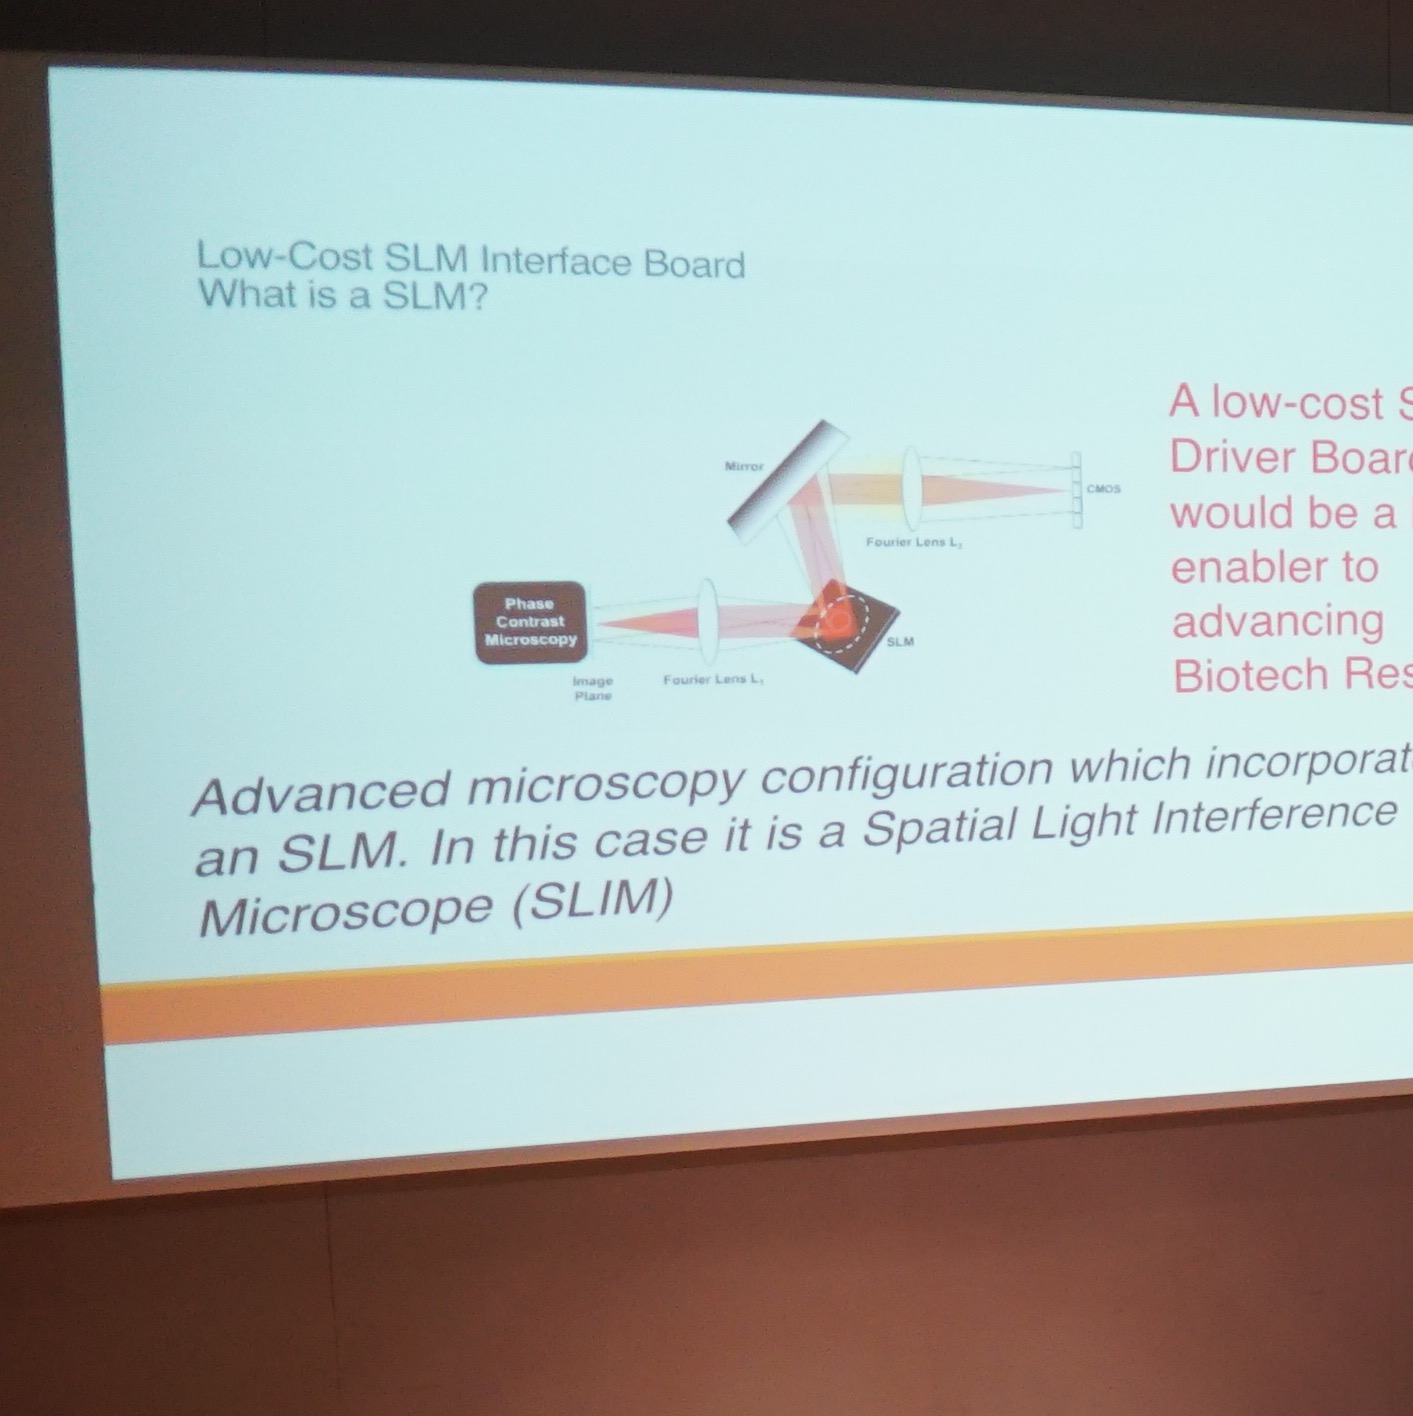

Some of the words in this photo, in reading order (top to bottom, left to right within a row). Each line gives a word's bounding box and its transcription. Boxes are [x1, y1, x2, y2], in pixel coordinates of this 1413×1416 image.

[198, 239, 373, 271] Low-Cost
[385, 242, 467, 272] SLM
[482, 244, 632, 276] Interface
[645, 248, 745, 279] Board
[198, 277, 296, 308] What
[309, 279, 337, 308] is
[350, 286, 370, 308] a
[384, 280, 488, 310] SLM?
[1169, 382, 1200, 417] A
[1213, 383, 1384, 420] low-cost
[725, 461, 765, 472] Mirror
[1171, 438, 1296, 473] Driver
[1087, 484, 1121, 494] CMOS
[1170, 495, 1293, 530] would
[1309, 495, 1358, 528] be
[1374, 503, 1397, 529] a
[866, 536, 912, 548] Fourier
[916, 536, 946, 548] Lens
[1172, 549, 1329, 584] enabler
[1342, 551, 1379, 583] to
[505, 597, 554, 610] Phase
[496, 615, 565, 628] Contrast
[1173, 603, 1384, 645] advancing
[484, 633, 578, 648] Microscopy
[887, 636, 915, 647] SLM
[573, 675, 613, 688] Image
[663, 674, 711, 686] Fourier
[715, 673, 747, 685] Lens
[1175, 657, 1328, 693] Biotech
[575, 690, 612, 701] Plane
[190, 769, 452, 817] Advanced
[468, 766, 747, 806] microscopy
[761, 752, 1053, 800] configuration
[1071, 746, 1191, 783] which
[195, 846, 258, 877] an
[278, 830, 407, 874] SLM.
[431, 828, 474, 866] In
[494, 824, 578, 863] this
[595, 820, 708, 858] case
[725, 816, 752, 852] it
[767, 815, 802, 851] is
[819, 820, 846, 849] a
[863, 806, 1019, 855] Spatial
[1032, 802, 1139, 848] Light
[1153, 797, 1399, 834] Interference
[200, 894, 494, 938] Microscope
[513, 876, 673, 929] (SLIM)
